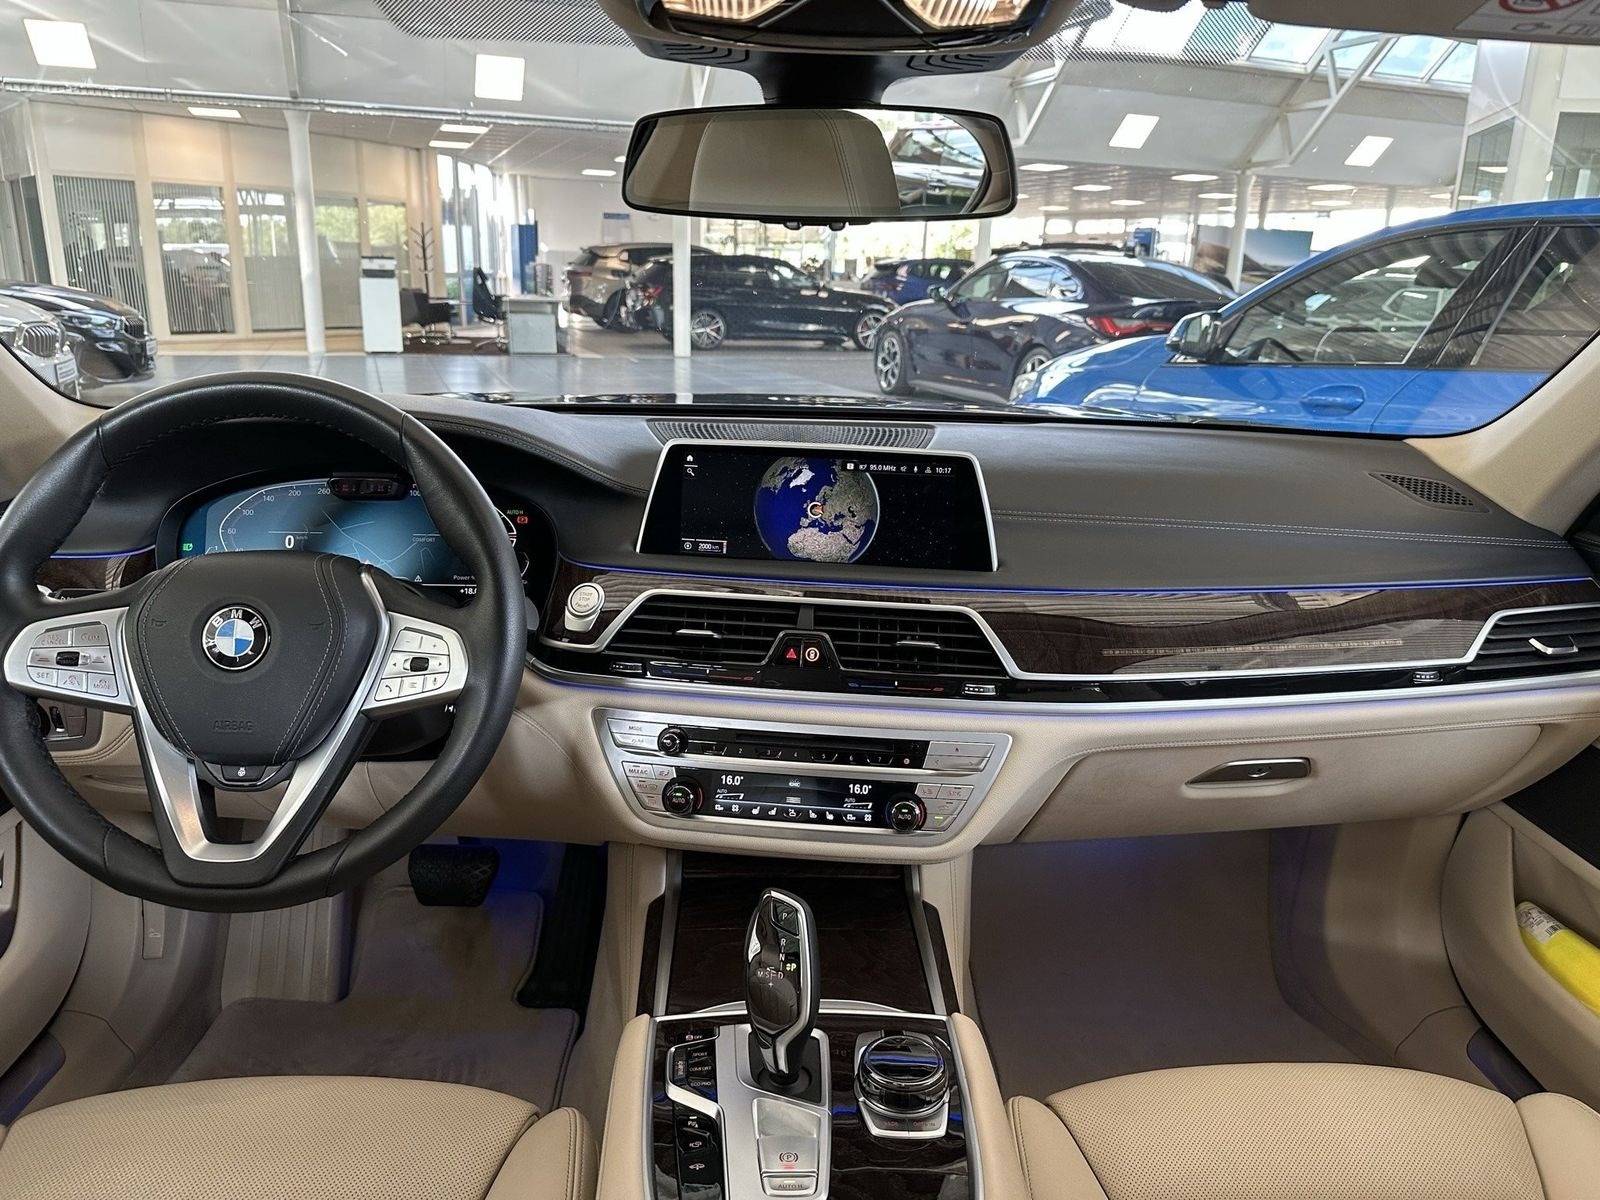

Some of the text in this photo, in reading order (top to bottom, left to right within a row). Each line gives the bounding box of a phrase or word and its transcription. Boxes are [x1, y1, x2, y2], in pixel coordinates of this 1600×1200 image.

[883, 464, 897, 472] MHz
[288, 489, 302, 497] 200
[317, 487, 331, 495] 260
[284, 534, 295, 549] 0
[211, 720, 253, 733] AIRBAG
